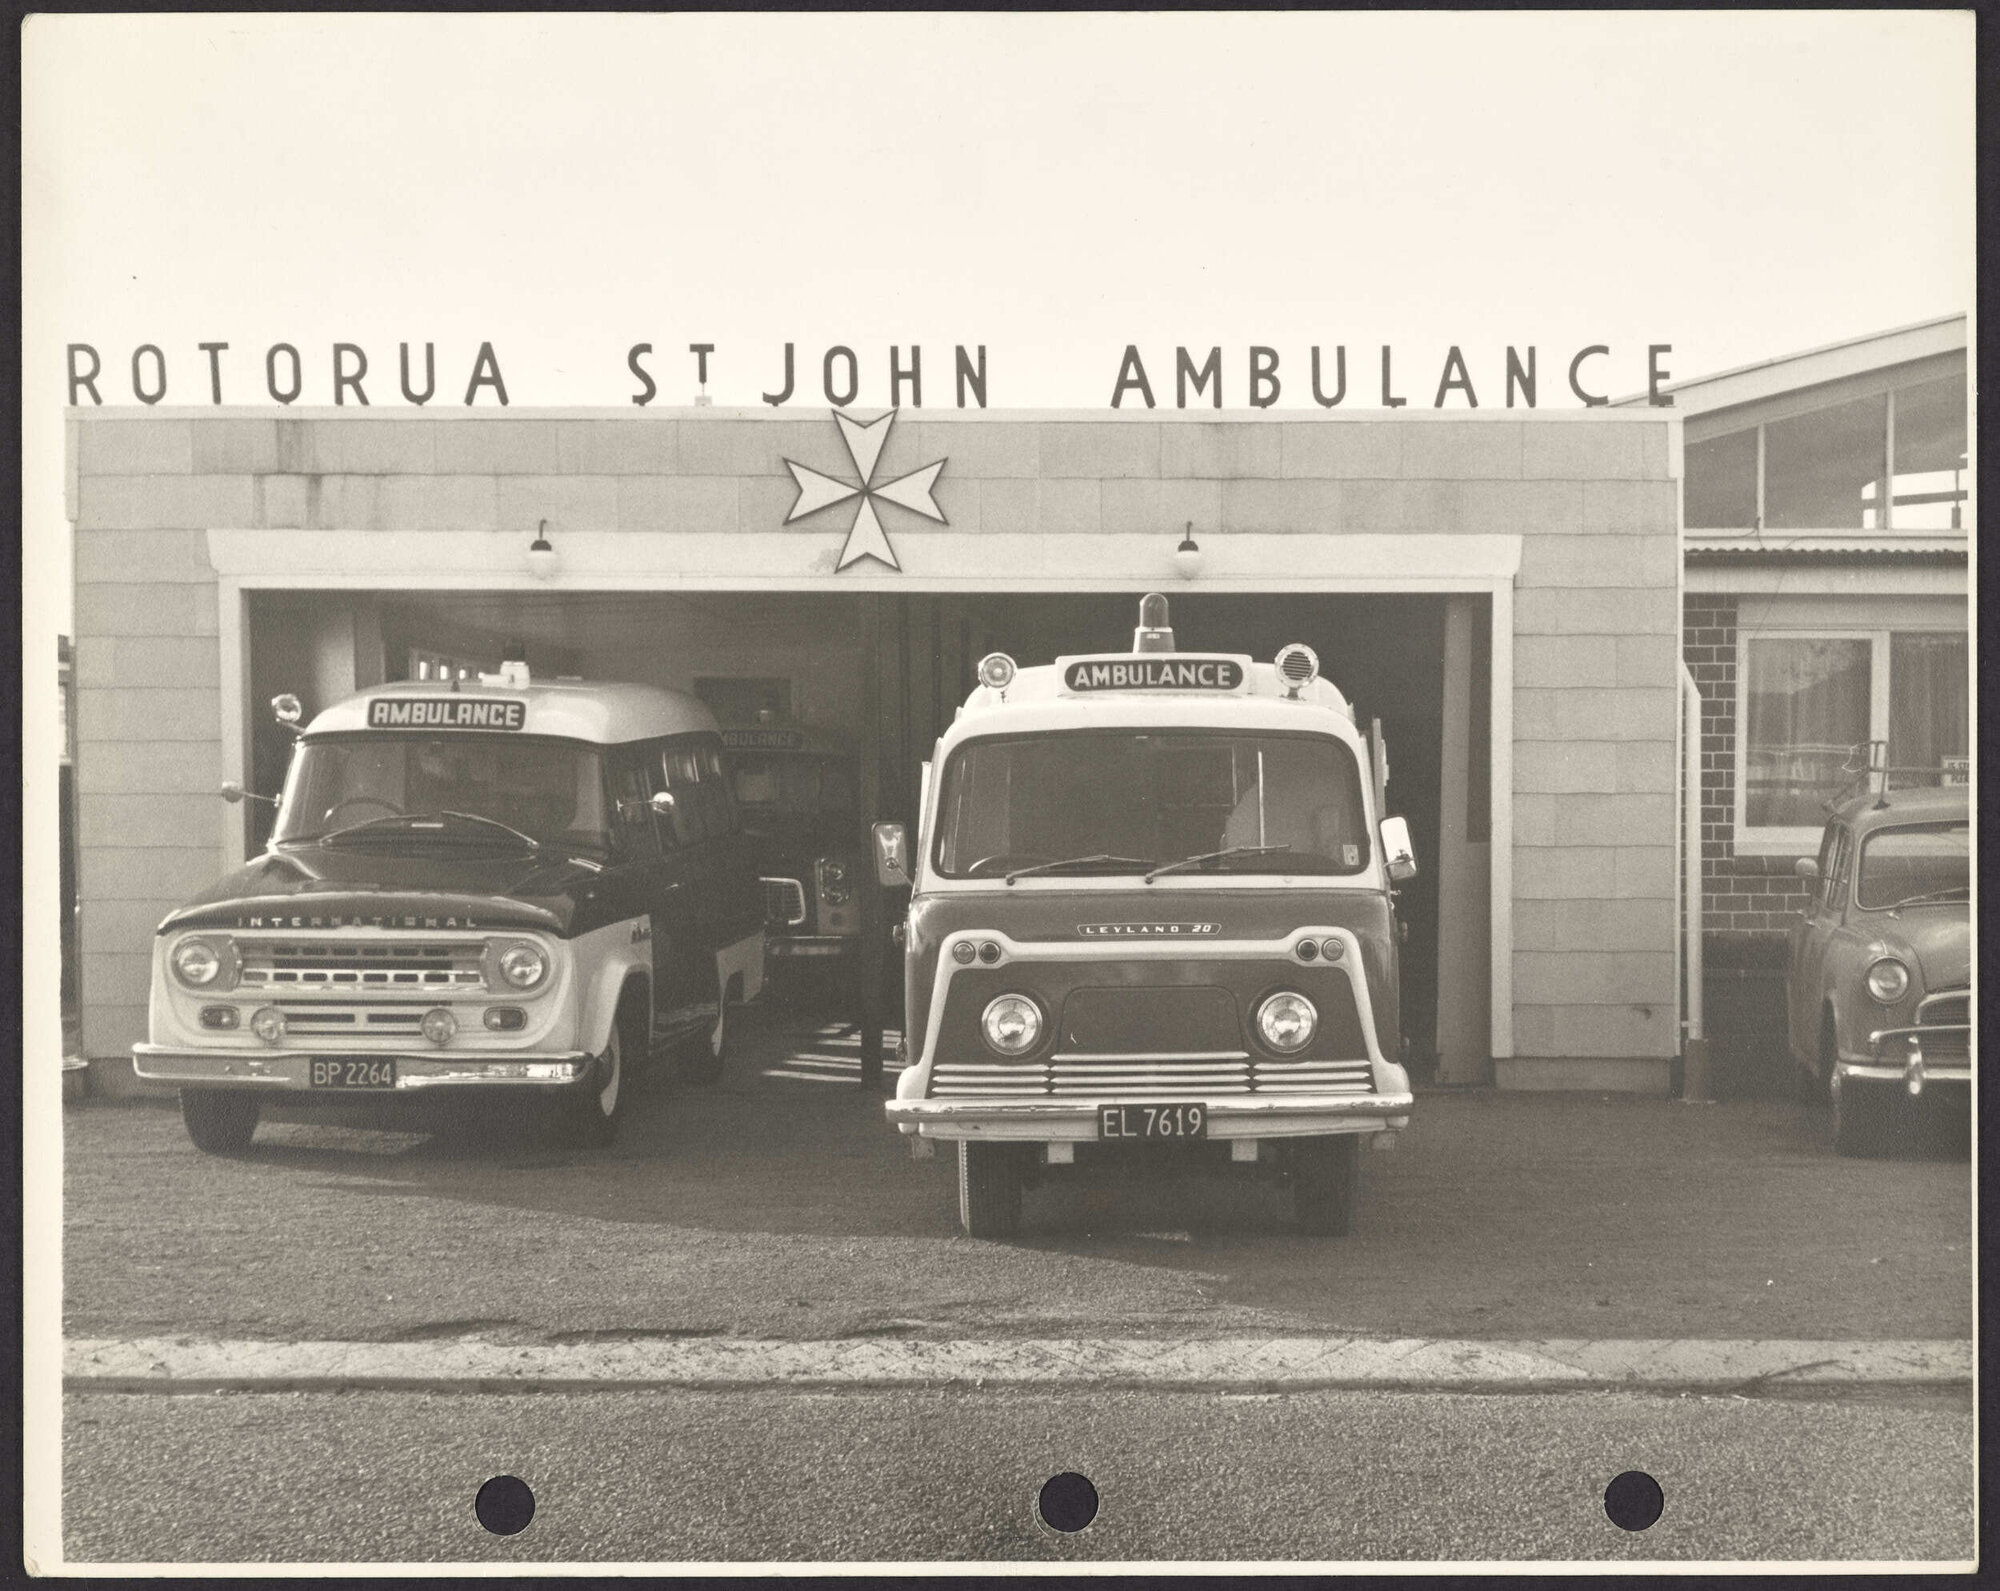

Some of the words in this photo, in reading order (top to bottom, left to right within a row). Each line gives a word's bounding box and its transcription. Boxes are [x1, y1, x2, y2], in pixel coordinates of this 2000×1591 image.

[67, 342, 509, 406] ROTORUA
[627, 343, 715, 406] ST
[762, 342, 988, 408] JOHN
[1110, 344, 1676, 408] AMBULANCE
[1073, 663, 1232, 687] AMBULANCE
[373, 702, 521, 726] AMBULANCE
[237, 916, 478, 928] INTERNATIONAL
[1085, 925, 1180, 934] LEYLAND
[1191, 924, 1212, 933] 20
[314, 1062, 341, 1085] BP
[345, 1062, 392, 1085] 2264
[1103, 1109, 1138, 1137] EL
[1143, 1107, 1202, 1137] 7619
